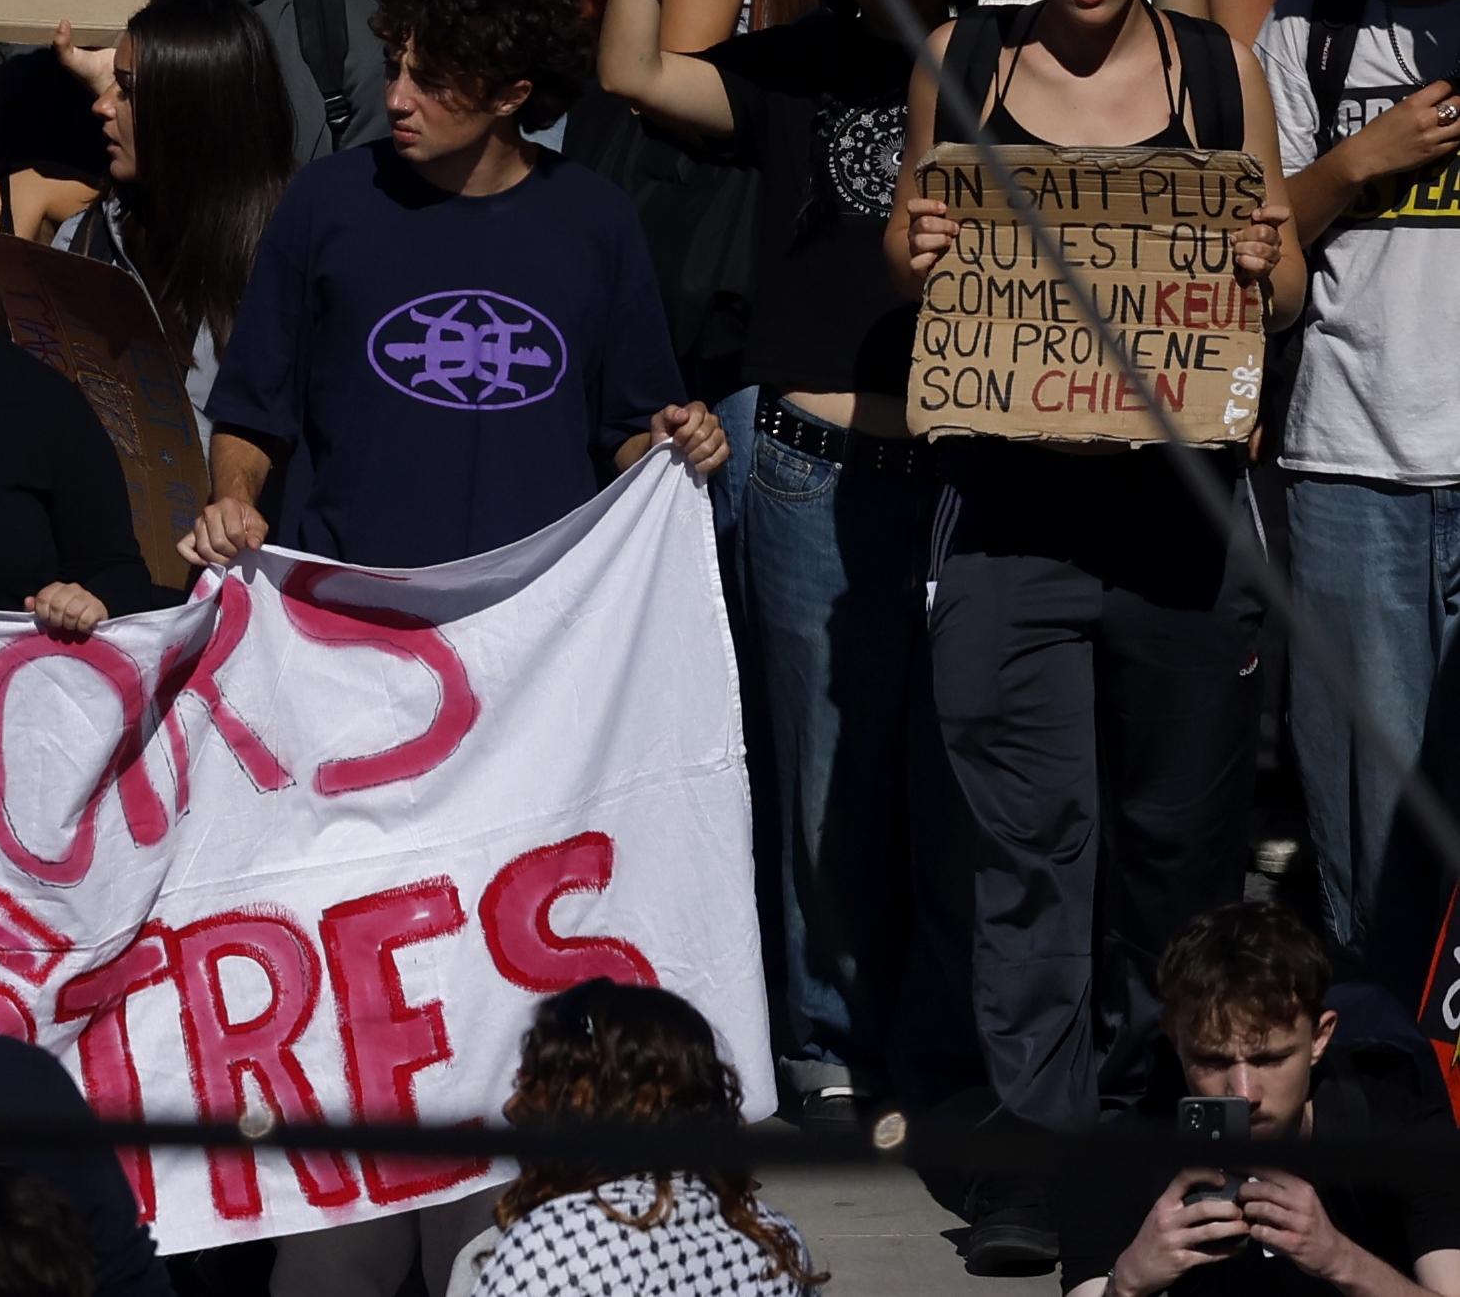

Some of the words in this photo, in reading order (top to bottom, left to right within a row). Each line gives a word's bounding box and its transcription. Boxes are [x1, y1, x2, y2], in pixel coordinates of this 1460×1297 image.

[1139, 168, 1264, 220] PLUS
[925, 270, 1080, 325] COMME
[919, 364, 1016, 414] SON
